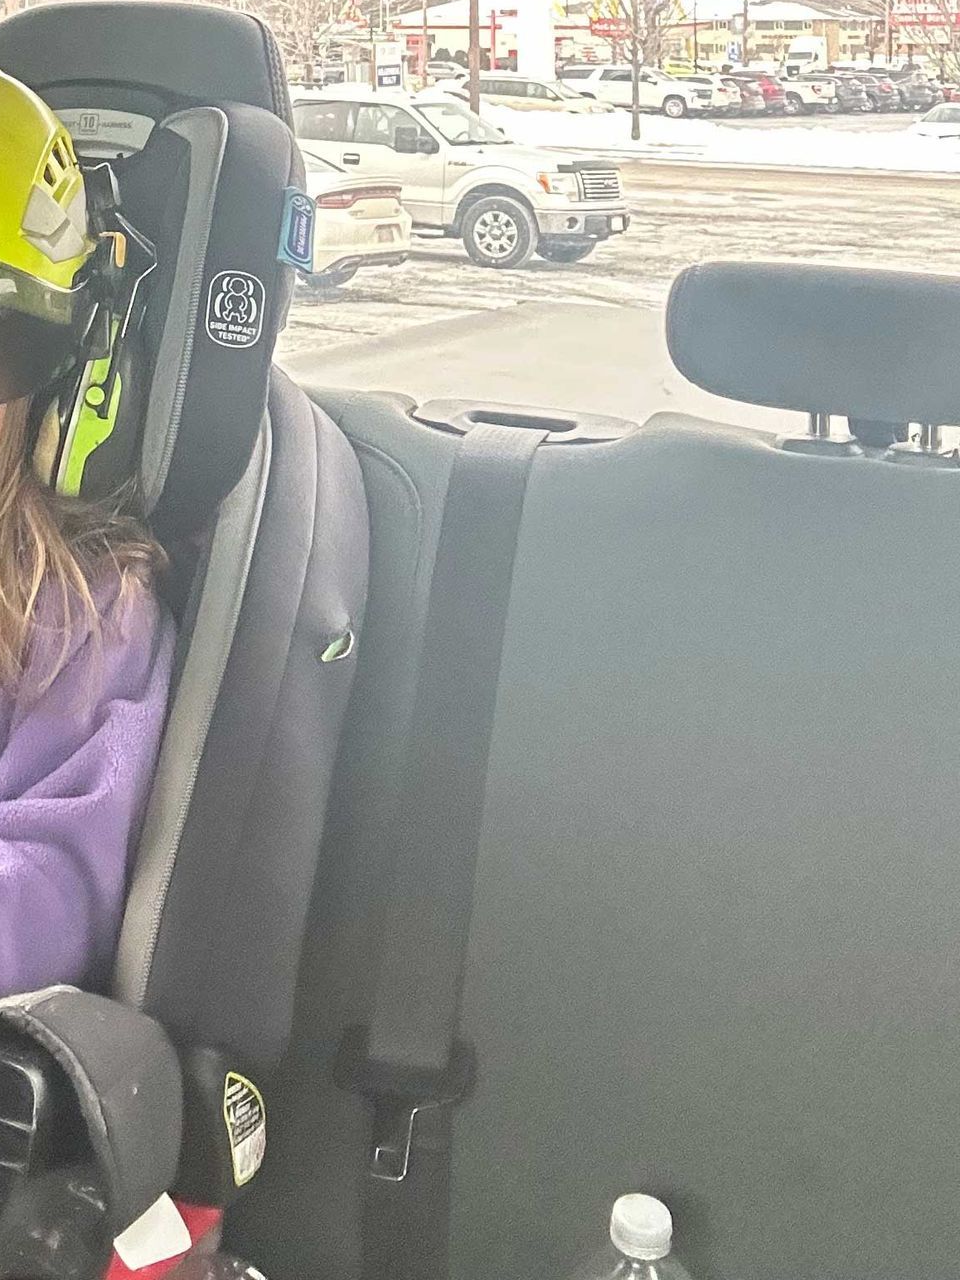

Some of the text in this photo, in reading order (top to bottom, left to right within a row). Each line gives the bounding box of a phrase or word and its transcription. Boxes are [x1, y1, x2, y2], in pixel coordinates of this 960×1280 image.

[83, 116, 95, 128] 10
[209, 321, 257, 336] SIDE IMPACT
